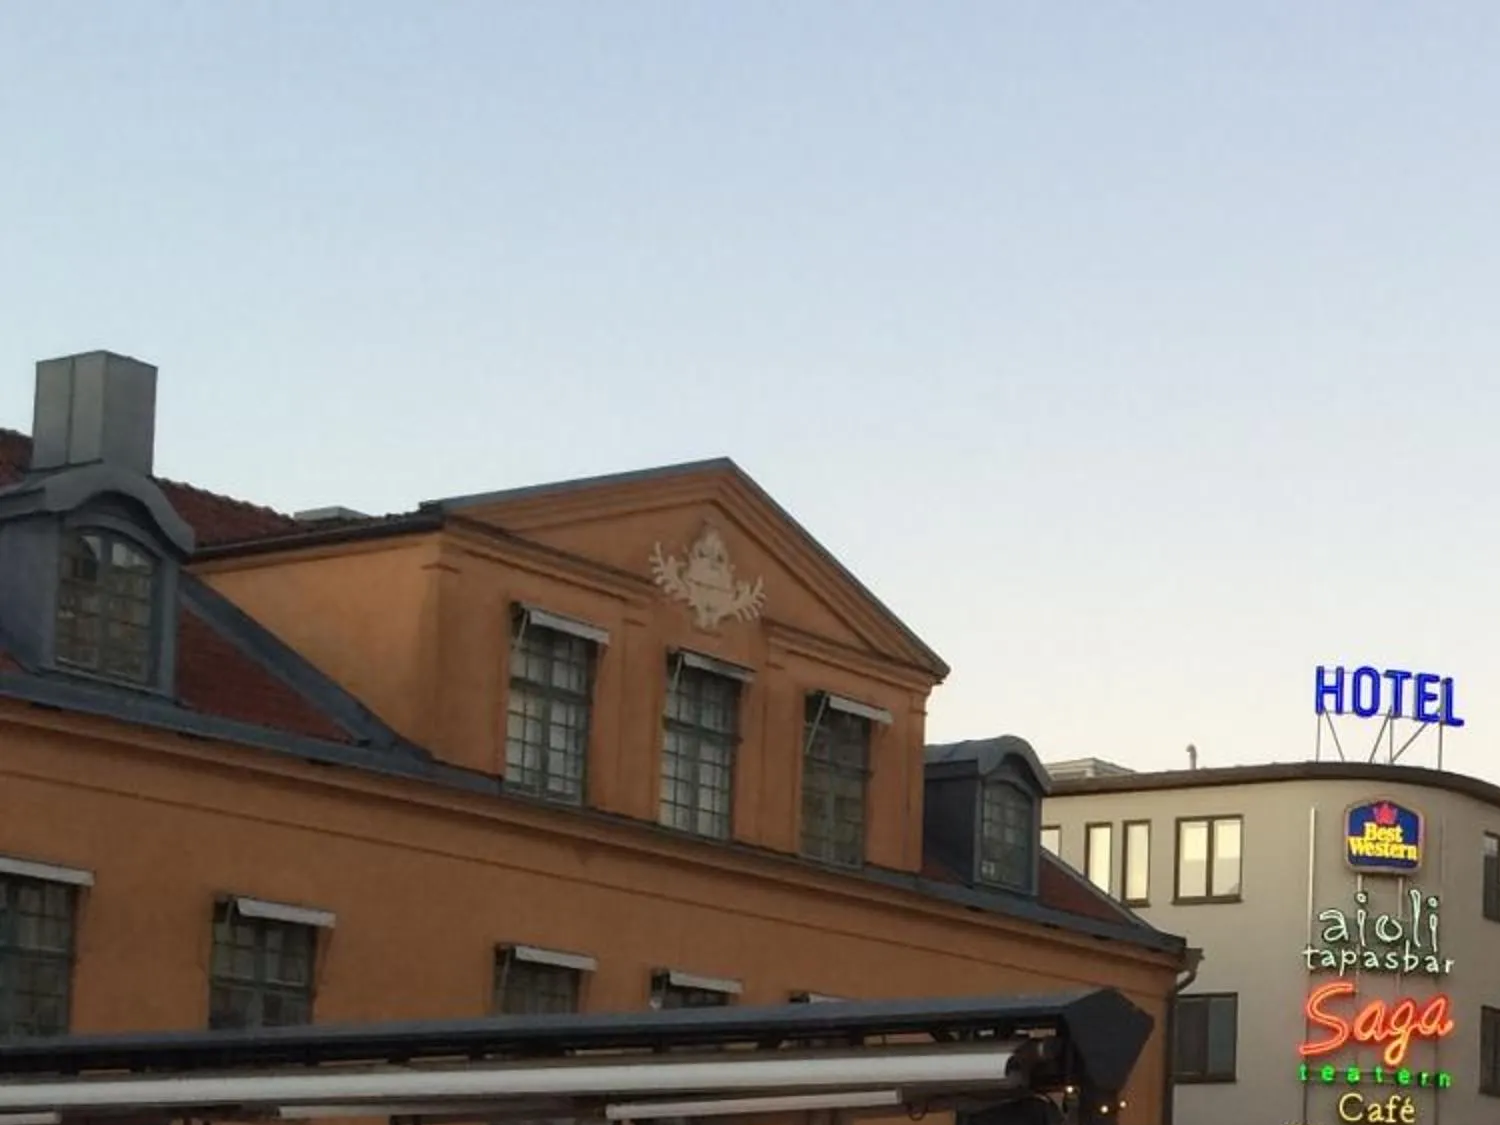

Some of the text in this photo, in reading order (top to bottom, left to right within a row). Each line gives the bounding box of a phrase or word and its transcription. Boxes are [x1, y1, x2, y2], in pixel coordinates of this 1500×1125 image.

[1315, 666, 1464, 727] HOTEL
[1348, 836, 1418, 861] Western
[1363, 821, 1404, 843] Best
[1319, 889, 1438, 952] aioli
[1301, 942, 1454, 977] tapasbar
[1298, 981, 1454, 1065] Saga
[1298, 1063, 1452, 1088] teatern
[1339, 1092, 1416, 1123] Café
